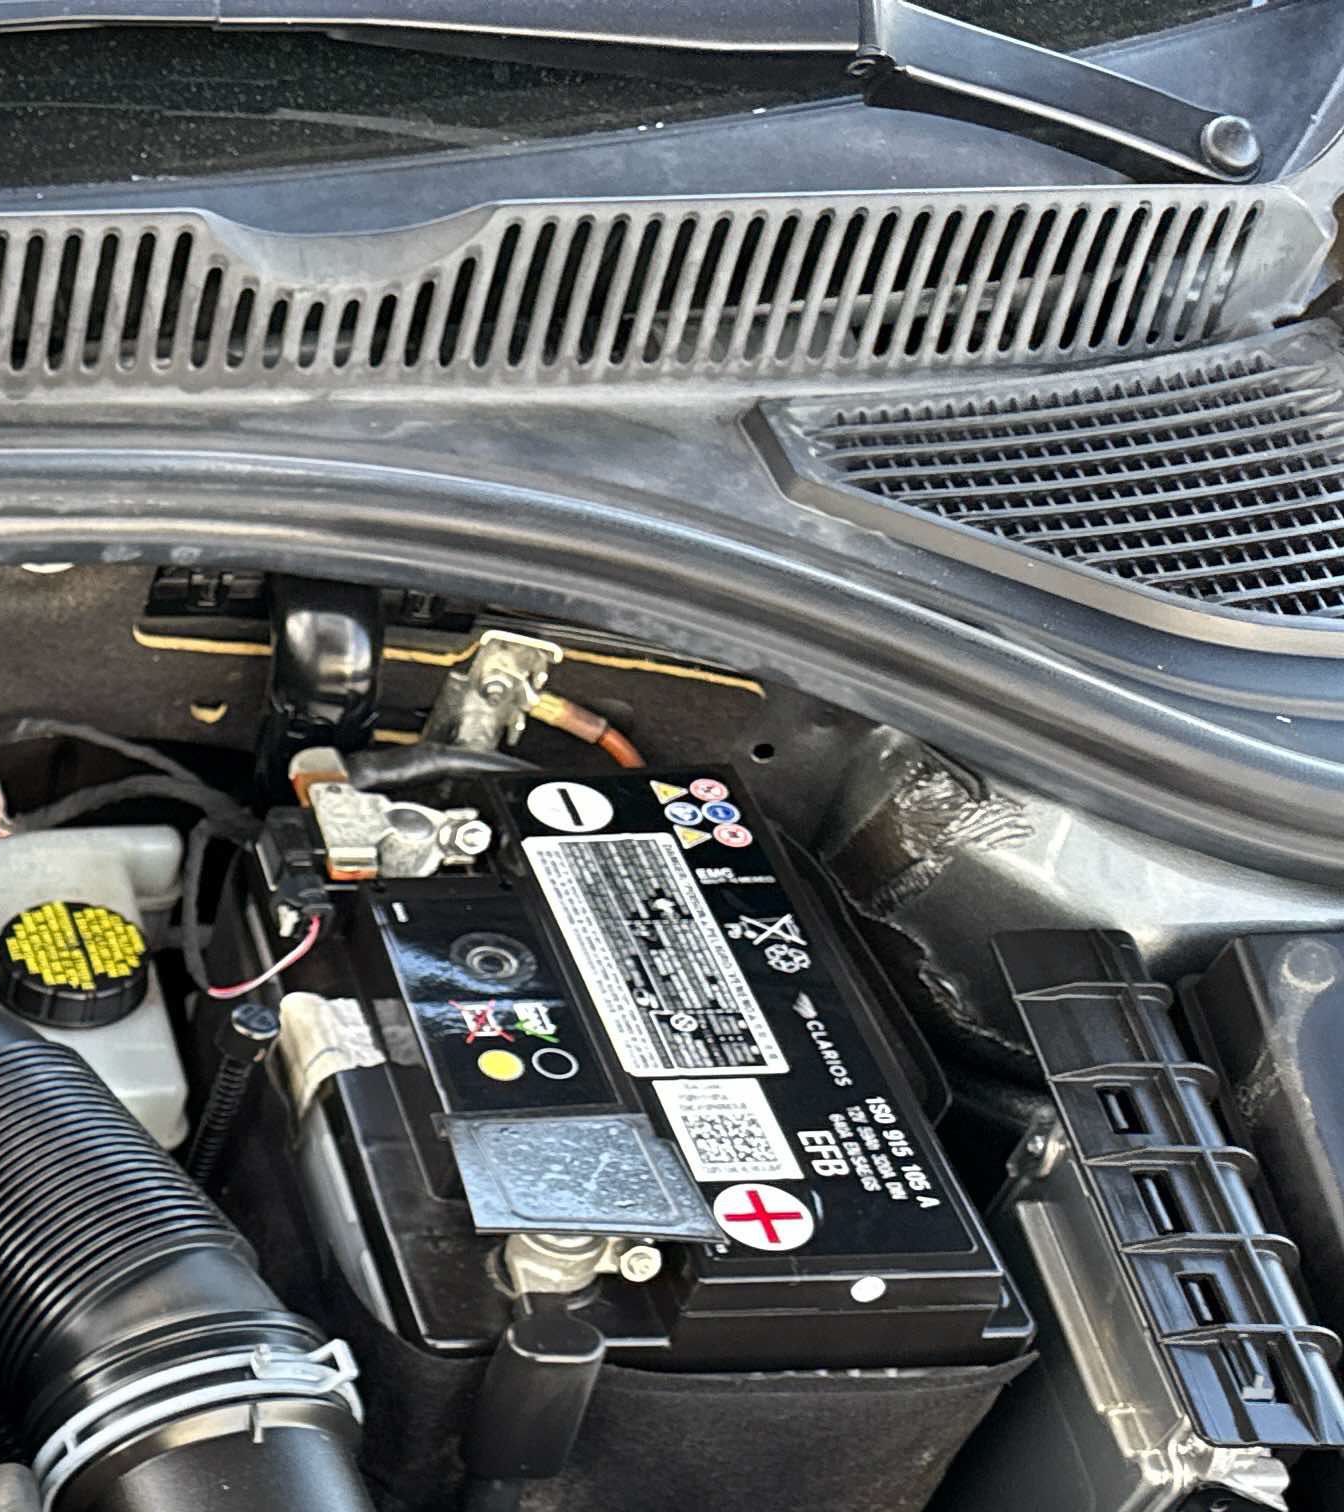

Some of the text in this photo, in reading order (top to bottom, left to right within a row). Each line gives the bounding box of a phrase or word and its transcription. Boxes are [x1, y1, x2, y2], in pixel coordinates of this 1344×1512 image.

[806, 1020, 853, 1086] CLARIOS
[797, 1130, 850, 1177] EFB
[882, 1129, 914, 1157] 915
[900, 1164, 932, 1191] 105
[916, 1195, 940, 1208] A
